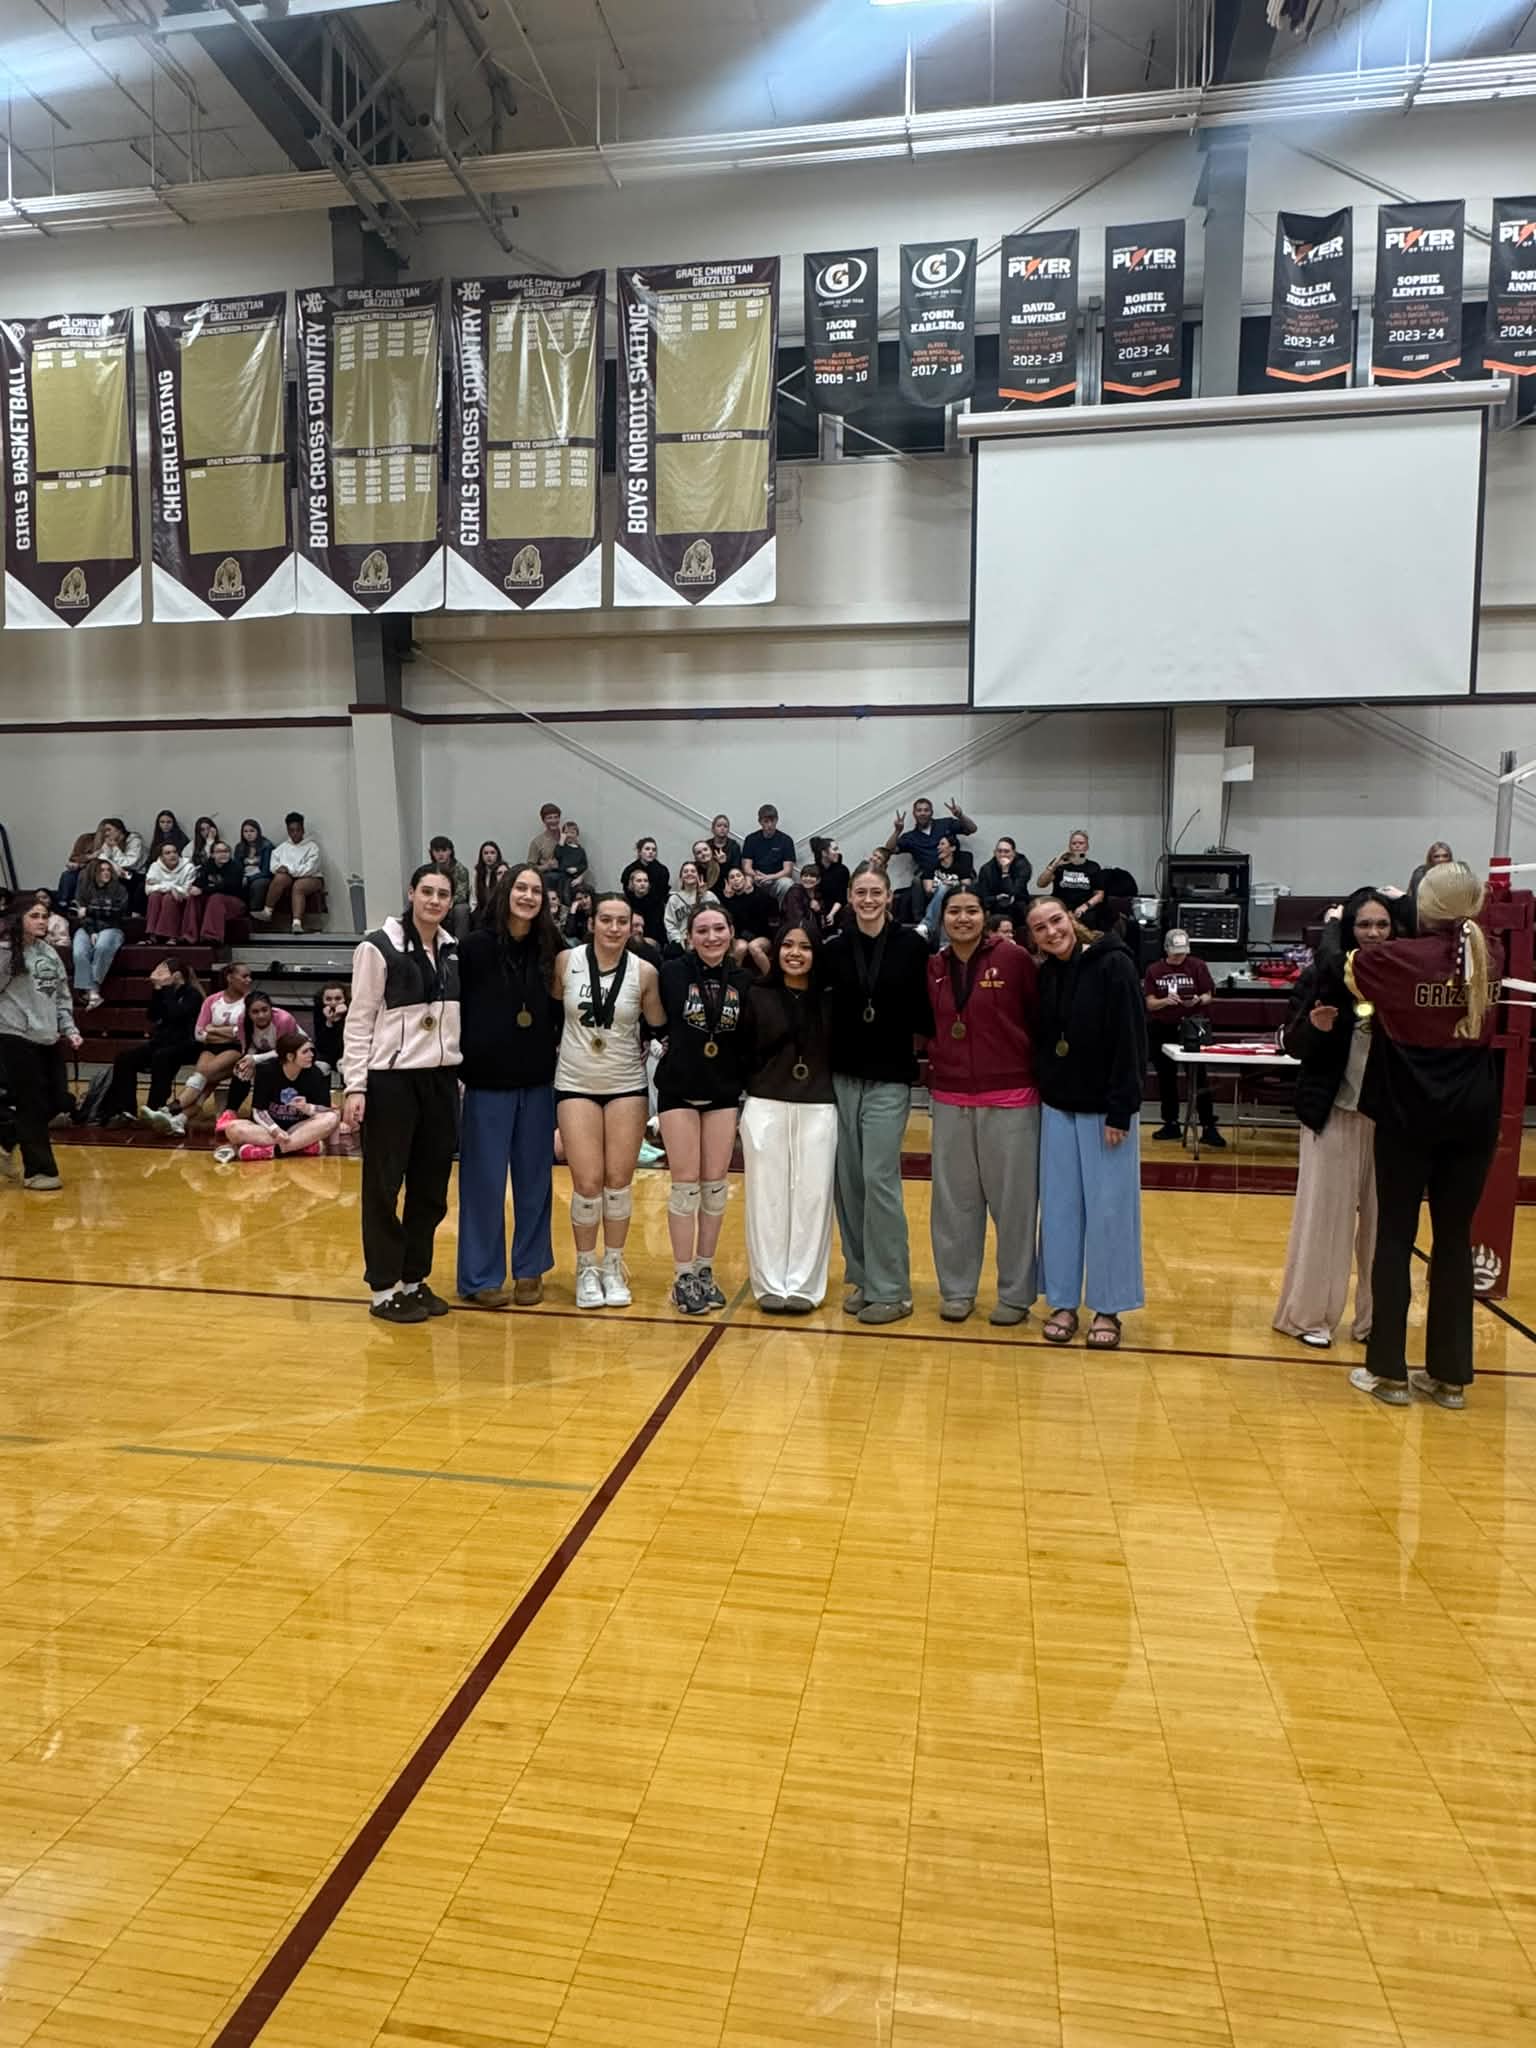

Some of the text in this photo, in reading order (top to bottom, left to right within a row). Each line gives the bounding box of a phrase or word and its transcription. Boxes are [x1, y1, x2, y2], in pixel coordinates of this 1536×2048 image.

[676, 264, 754, 279] GRACE CHRISTIAN
[692, 275, 736, 287] GRIZZLIES
[1397, 274, 1440, 286] SOPHIE
[1125, 292, 1164, 304] ROBBIE
[1022, 302, 1055, 313] DAVID
[1122, 303, 1167, 316] ANNETT
[922, 310, 954, 321] TOBIN
[1011, 312, 1066, 324] SLIWINSKI
[826, 319, 857, 331] JACOB
[829, 331, 854, 341] KIRK
[1284, 334, 1335, 348] 2023-24
[1389, 328, 1444, 342] 2023-24
[1119, 344, 1170, 359] 2023-24
[1013, 352, 1063, 366] 2022-23
[815, 373, 844, 384] 2009
[856, 370, 868, 382] 10
[912, 364, 938, 377] 2017
[950, 363, 963, 375] 18
[627, 304, 649, 534] BOYS NORDIC SKIING
[460, 306, 482, 547] GIRLS CROSS COUNTRY
[306, 321, 329, 548] BOYS CROSS COUNTRY
[682, 432, 743, 442] STATE CHAMPIONS
[158, 370, 182, 523] CHEERLEADING
[9, 362, 31, 550] GIRLS BASKETBALL
